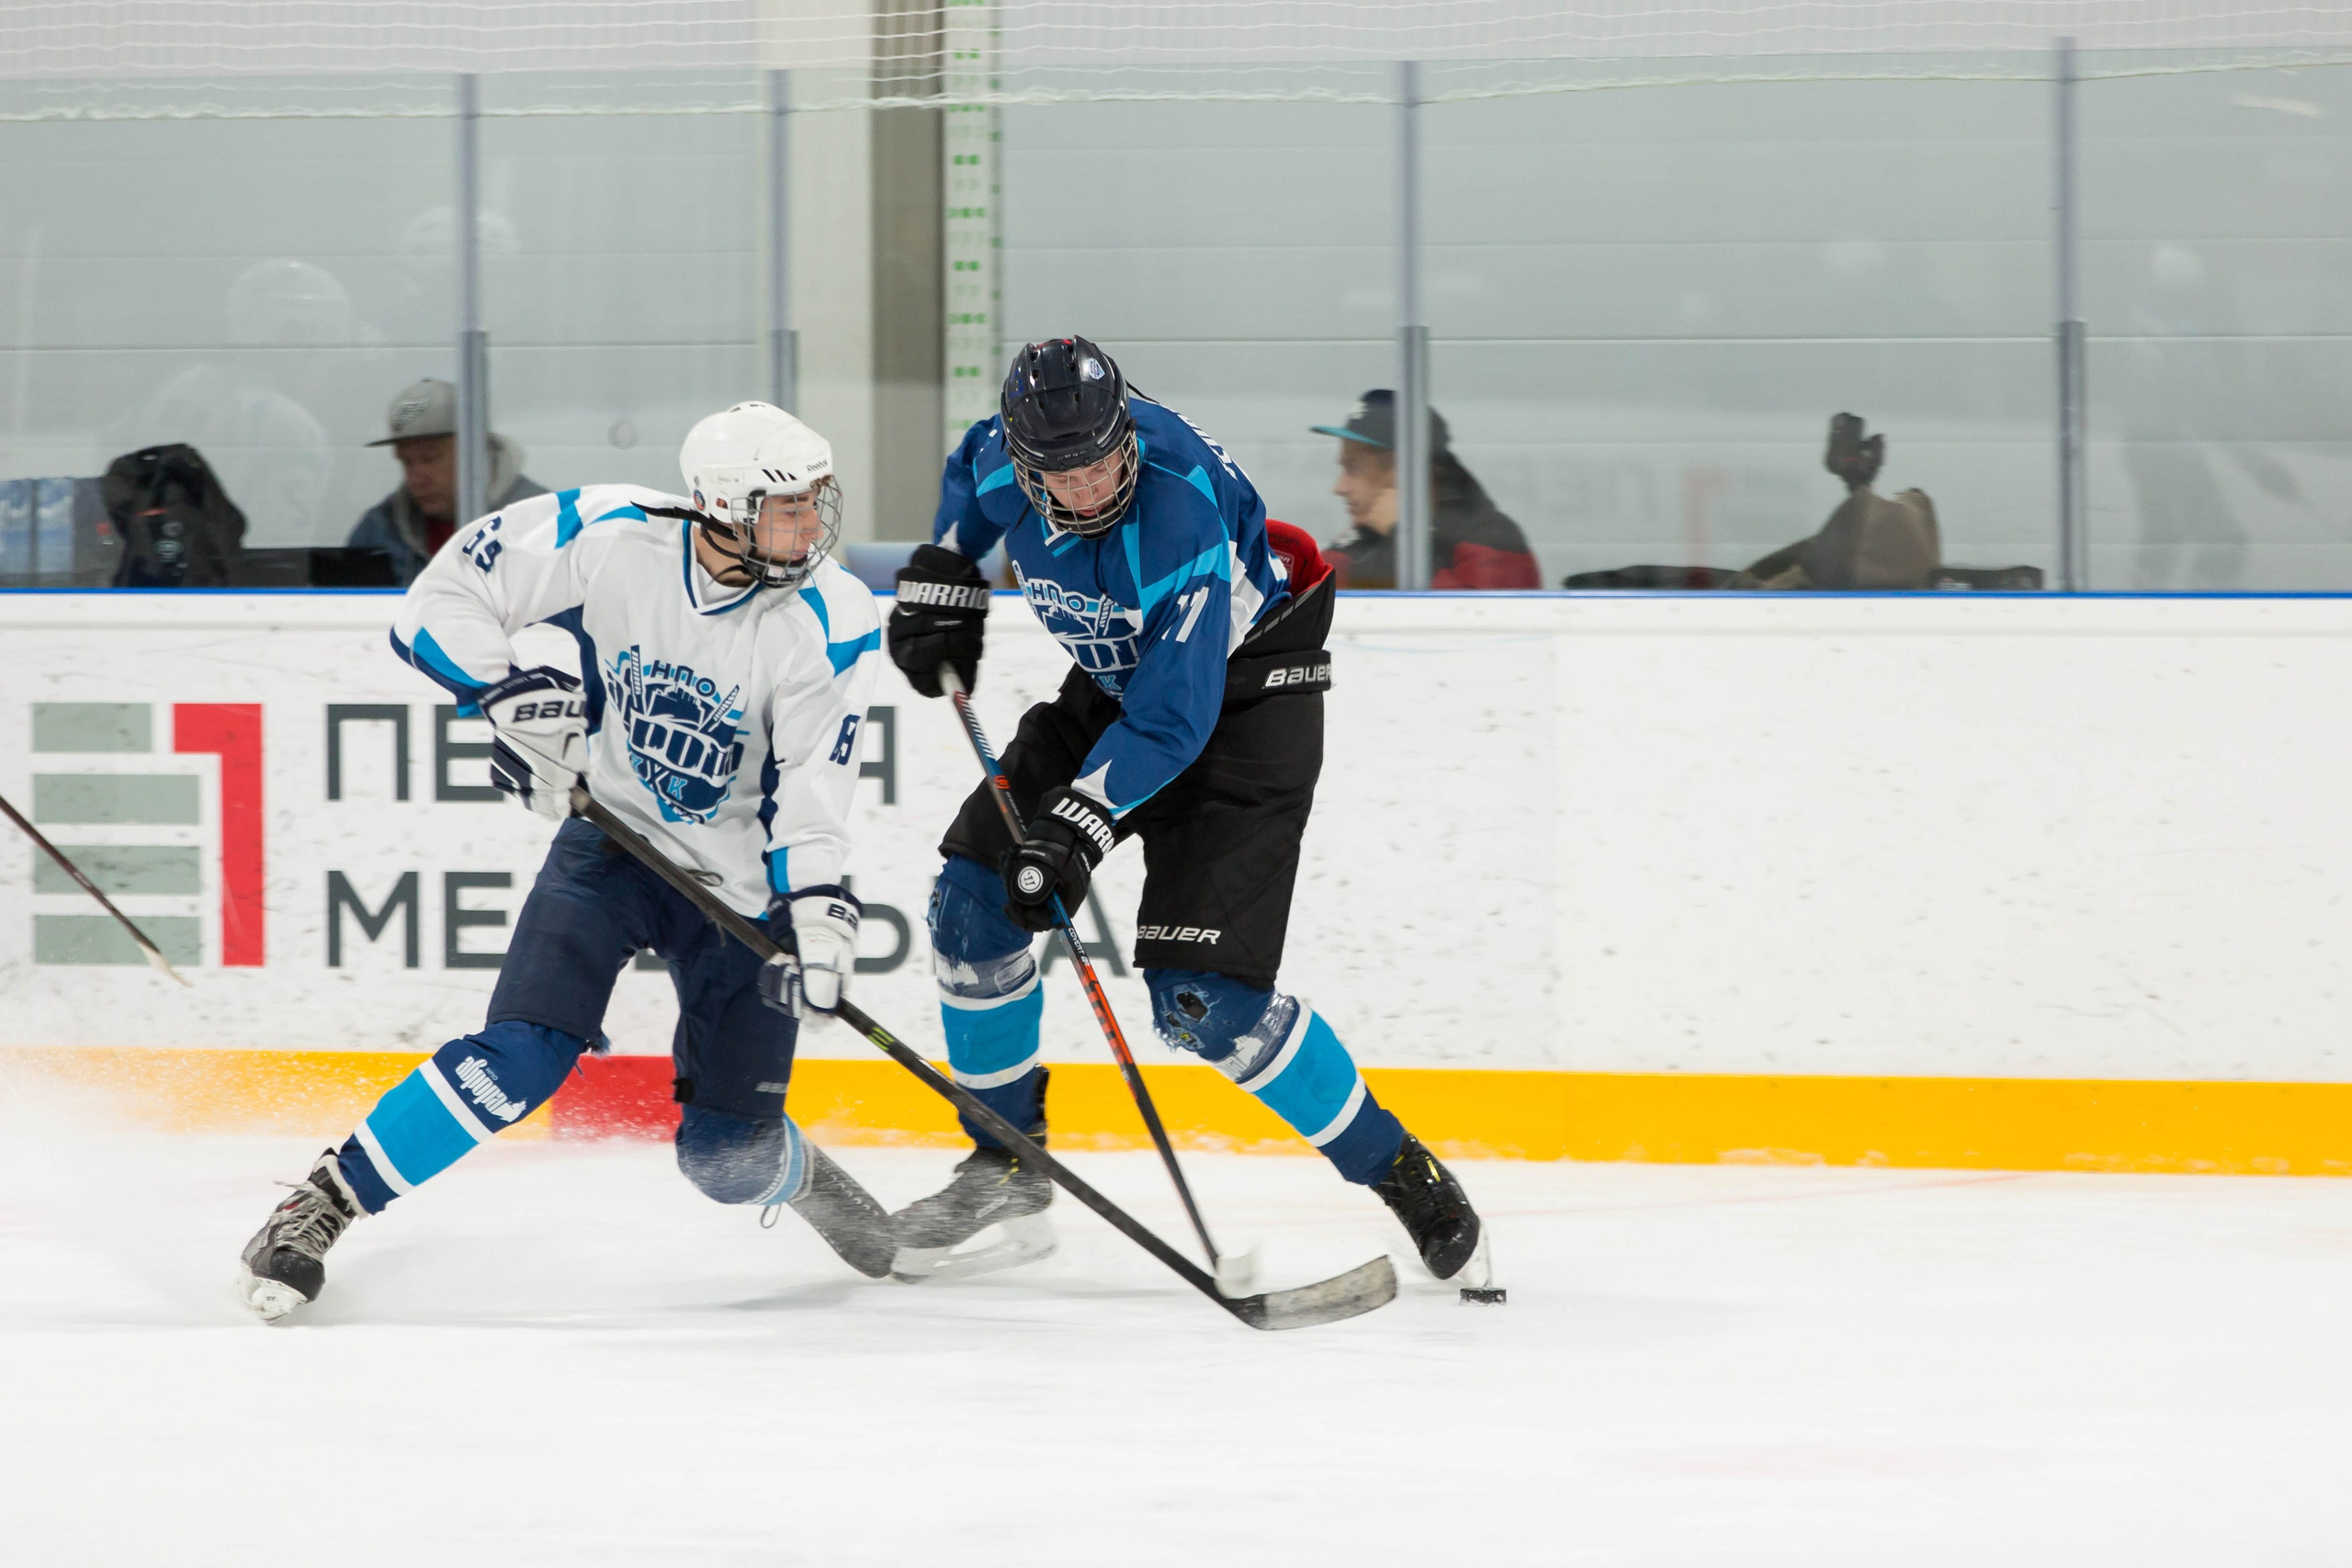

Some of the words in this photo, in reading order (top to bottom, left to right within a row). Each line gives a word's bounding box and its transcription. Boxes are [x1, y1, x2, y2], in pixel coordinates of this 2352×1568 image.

[897, 580, 990, 610] WARRIO
[1031, 580, 1087, 614] НПО
[650, 660, 717, 698] НПО
[512, 700, 586, 723] BAU
